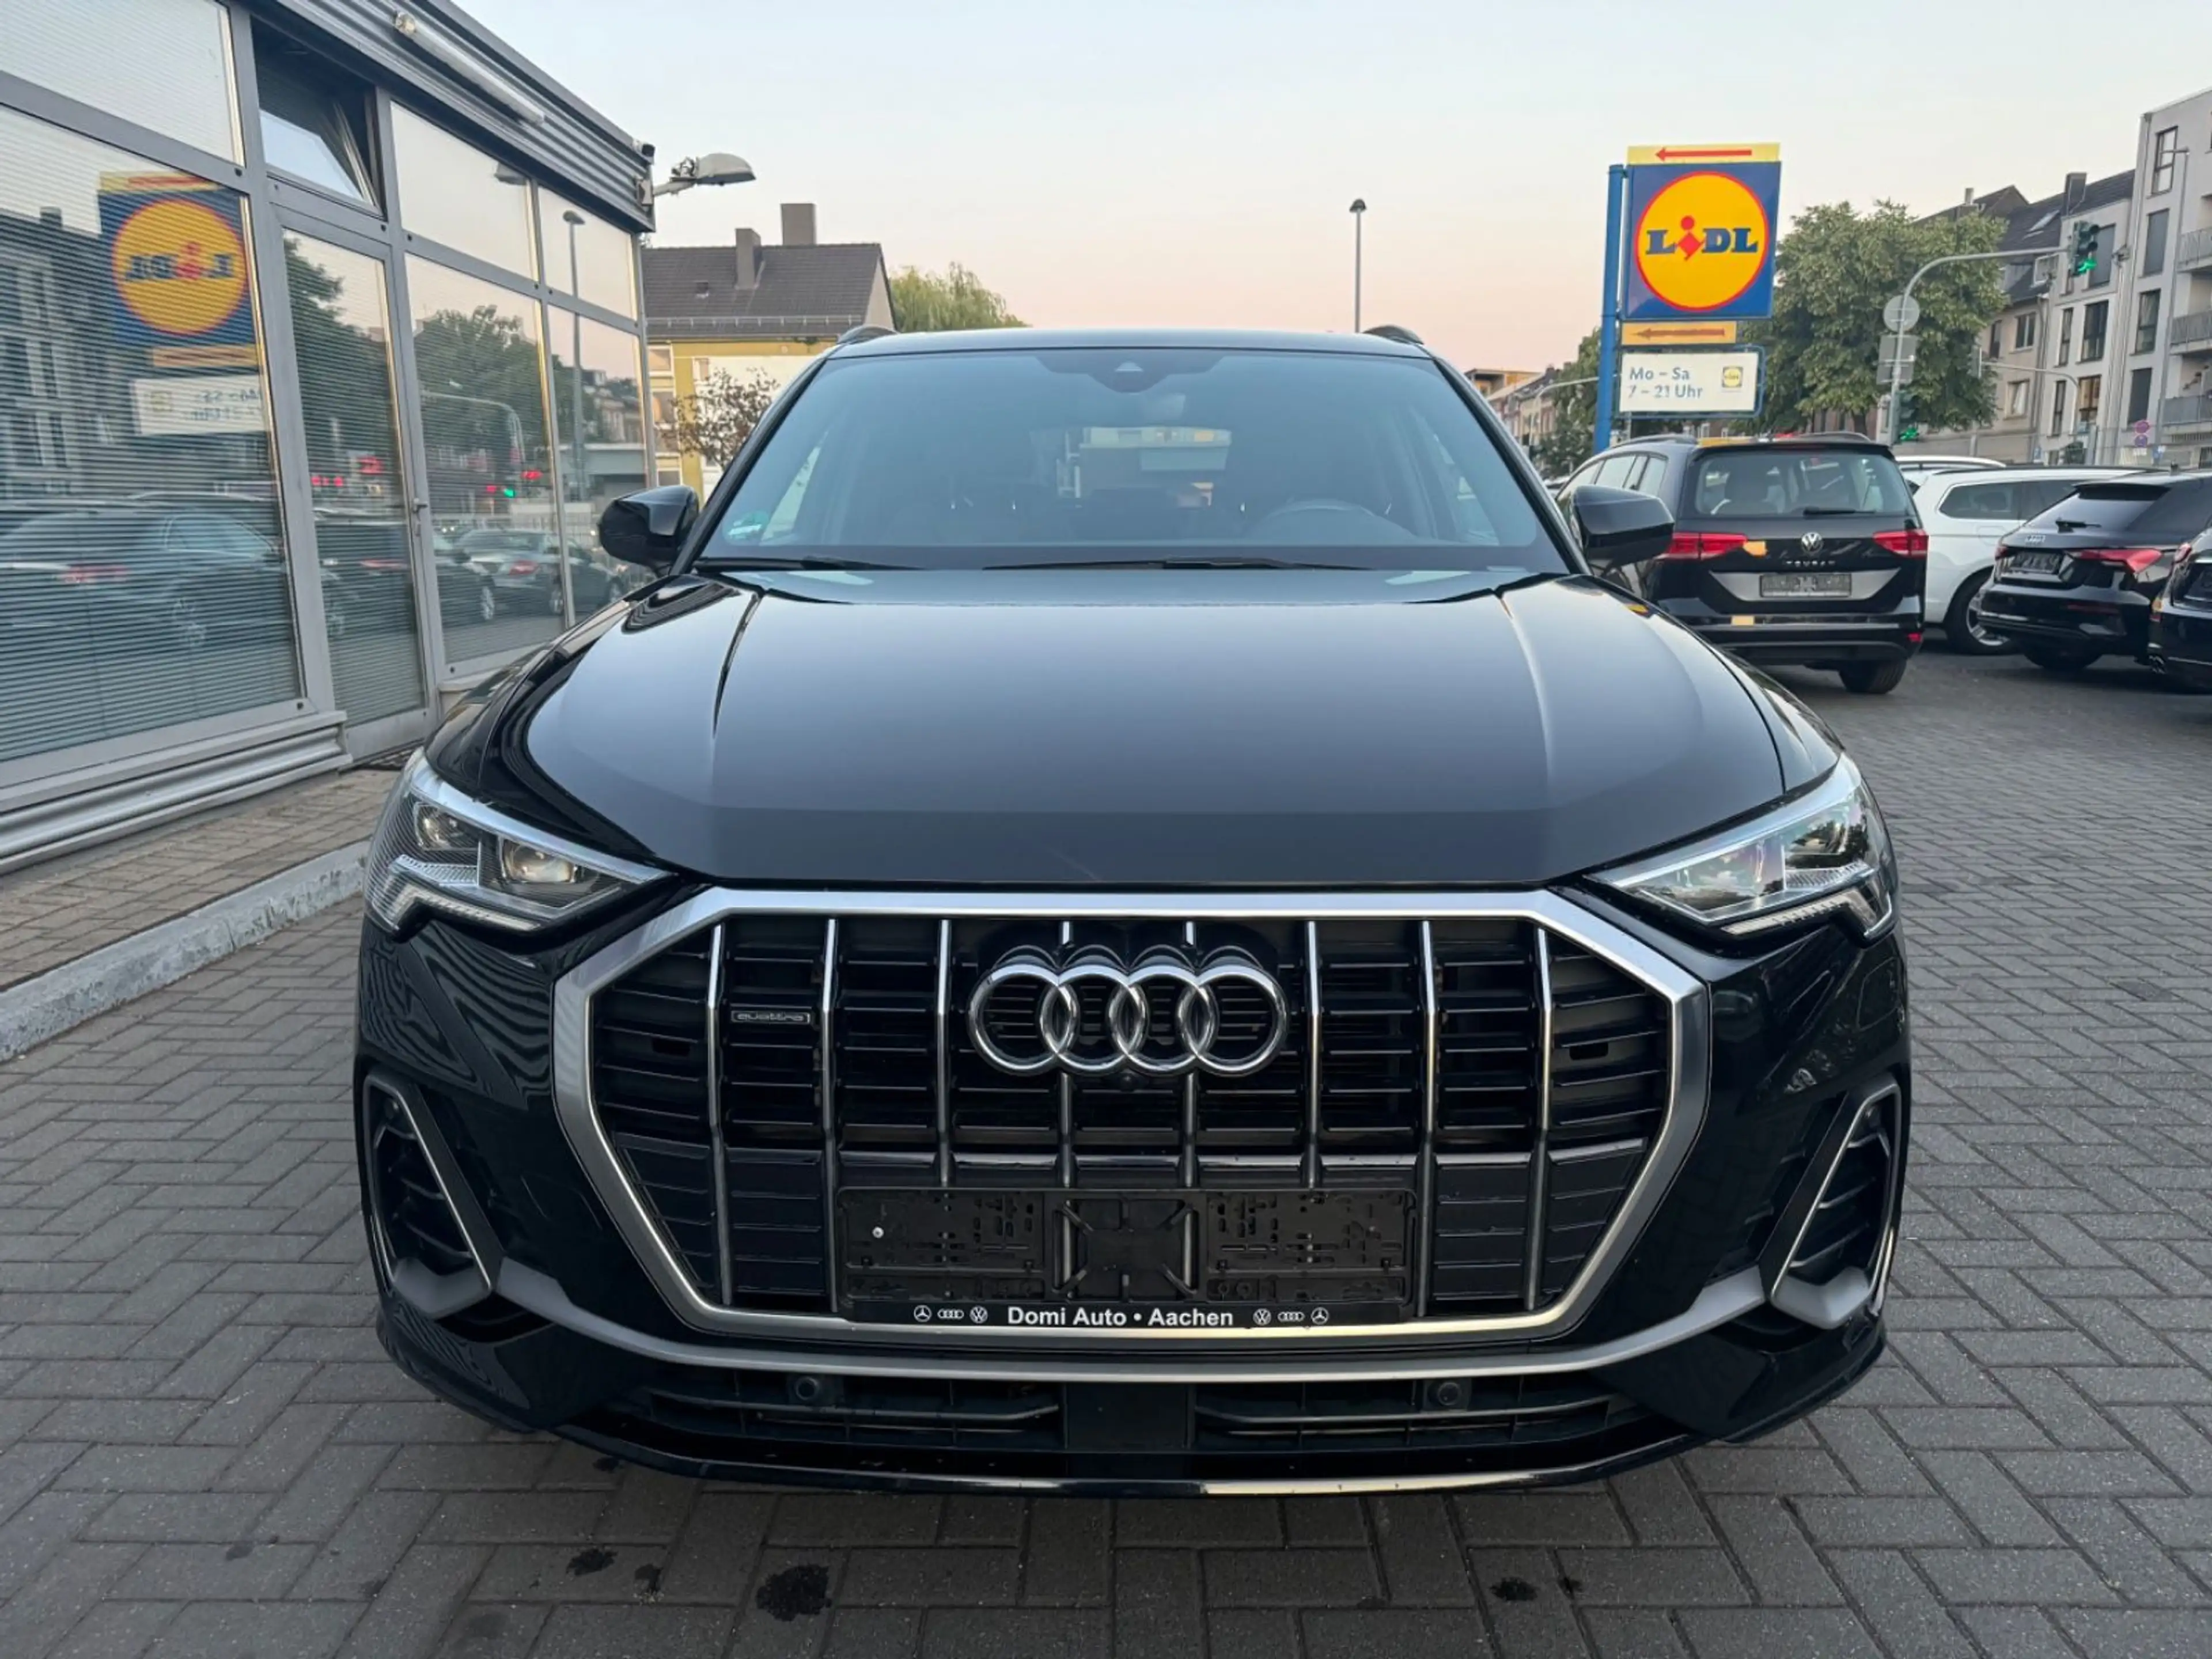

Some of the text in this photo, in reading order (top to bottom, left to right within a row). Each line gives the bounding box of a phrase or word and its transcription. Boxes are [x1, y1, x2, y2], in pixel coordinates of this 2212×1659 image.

[1629, 366, 1654, 380] Mo
[1672, 366, 1690, 380] Sa
[1675, 384, 1703, 399] Uhr
[1008, 1306, 1066, 1325] Domi
[1073, 1307, 1127, 1325] Auto
[1147, 1308, 1233, 1326] Aachen
